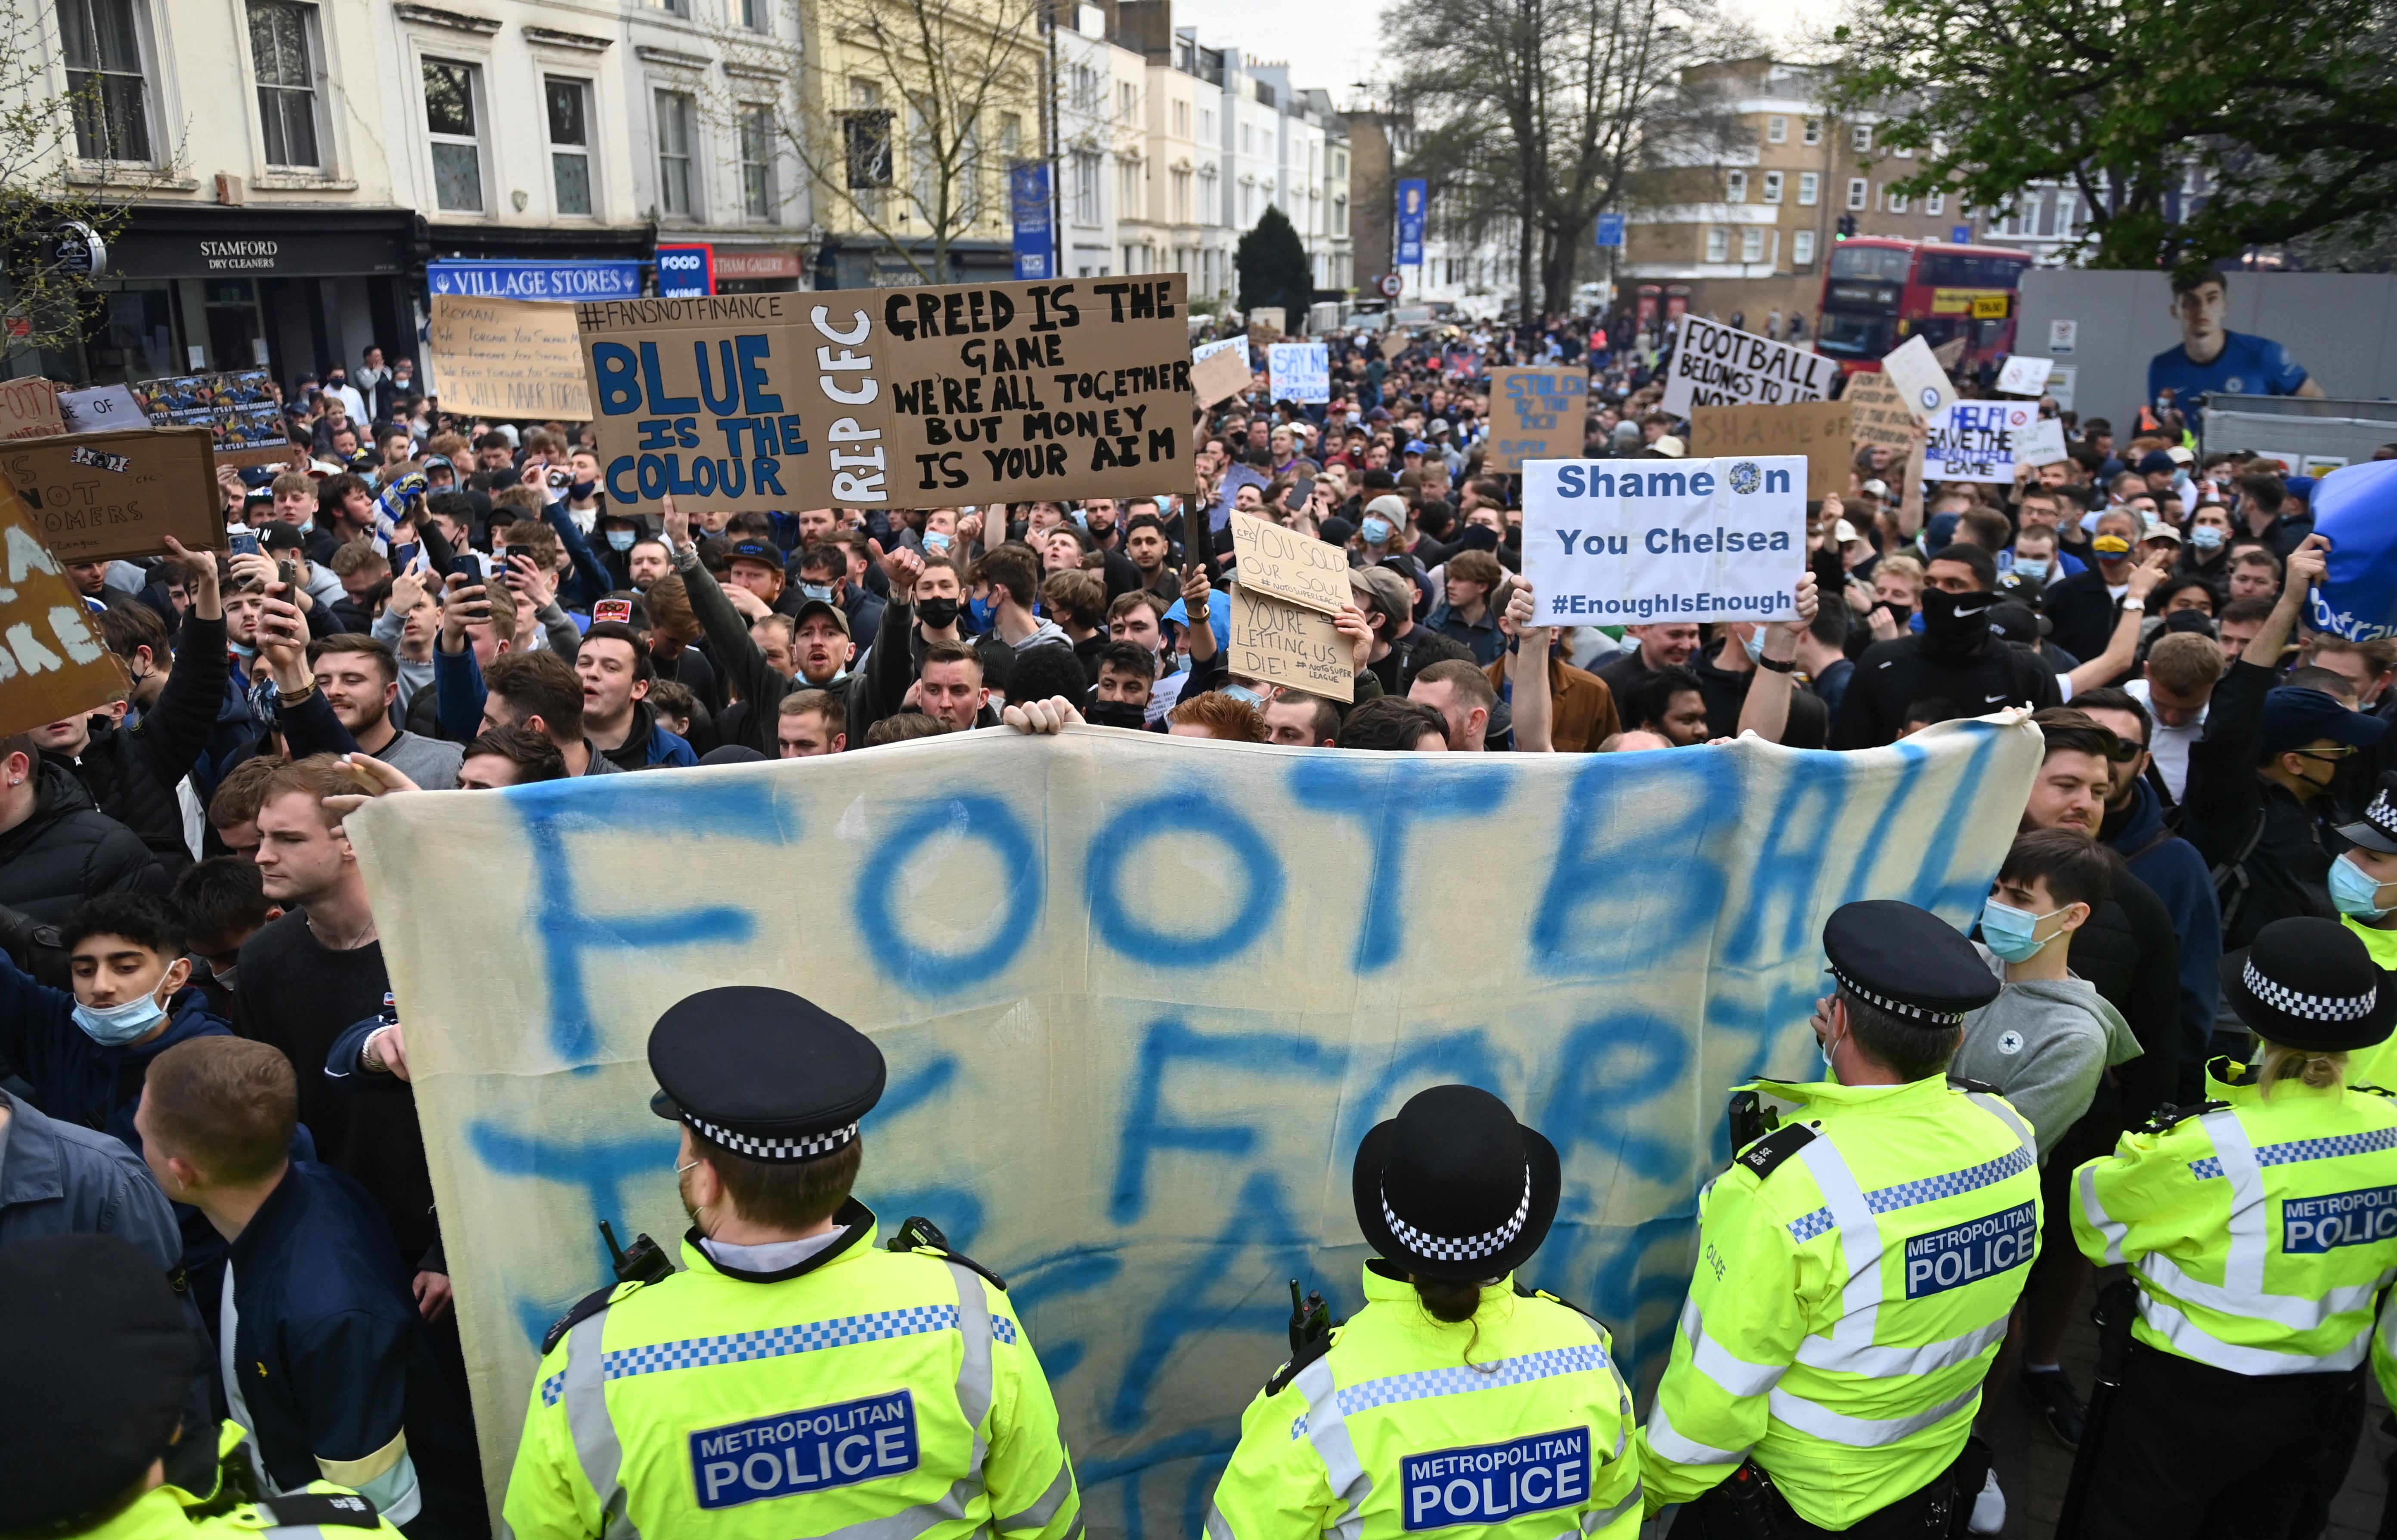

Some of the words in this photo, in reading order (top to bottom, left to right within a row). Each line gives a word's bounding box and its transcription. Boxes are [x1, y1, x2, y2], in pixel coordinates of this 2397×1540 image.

[200, 241, 278, 256] STAMFORD
[209, 259, 227, 269] DRY
[229, 258, 274, 269] CLEANERS
[661, 256, 700, 270] FOOD
[747, 258, 783, 272] GALLERY
[453, 270, 547, 295] VILLAGE
[551, 269, 621, 294] STORES
[666, 288, 702, 297] WINE
[579, 297, 783, 331] #FANSNOTFINANCE
[885, 289, 1014, 341] GREED
[1028, 284, 1080, 331] IS
[1093, 281, 1176, 324] THE
[810, 304, 879, 405] CFC
[961, 334, 1065, 375] GAME
[1274, 348, 1306, 373] SAY
[1311, 347, 1329, 373] NO
[1685, 320, 1818, 389] FOOTBALL
[592, 334, 784, 416] BLUE
[892, 372, 983, 416] WE'RE
[991, 374, 1045, 413] ALL
[1054, 360, 1191, 404] TOGETHER
[1505, 373, 1587, 398] STOLEN
[1680, 353, 1754, 396] BELONGS
[1760, 378, 1782, 402] TO
[0, 381, 54, 420] OOTY
[93, 399, 113, 414] OF
[248, 400, 276, 409] DISGRACE
[439, 381, 458, 403] WE
[465, 381, 499, 409] WILL
[508, 381, 545, 410] NEVER
[1542, 397, 1568, 411] THE
[184, 407, 211, 415] DISGRACE
[925, 416, 1003, 445] BUT
[1023, 404, 1148, 442] MONEY
[1521, 414, 1557, 430] RICH
[1951, 406, 2007, 430] HELP!
[260, 437, 287, 446] DISGRACE
[638, 417, 700, 450] IS
[716, 414, 808, 458] THE
[1701, 413, 1813, 446] SHAME
[1926, 427, 1974, 448] SAVE
[1979, 430, 2013, 451] THE
[915, 451, 969, 490] IS
[982, 443, 1068, 482] YOUR
[1091, 427, 1176, 472] AIM
[1499, 439, 1546, 455] SUPER
[606, 453, 787, 504] COLOUR
[1556, 464, 1715, 498] Shame
[1945, 461, 1994, 476] GAME
[19, 480, 100, 510] NOT
[43, 501, 142, 532] OMERS
[1237, 529, 1255, 540] CFC
[1242, 517, 1295, 560] YOU
[1300, 541, 1345, 572] SOLD
[1555, 529, 1628, 555] You
[1645, 527, 1789, 554] Chelsea
[1243, 556, 1282, 580] OUR
[1296, 571, 1344, 599] SOUL
[1240, 593, 1306, 635] YOU'RE
[1552, 591, 1791, 618] #EnoughIsEnough
[1237, 624, 1307, 660] LETTING
[1313, 644, 1337, 664] US
[1246, 652, 1287, 676] DIE!
[1310, 671, 1339, 683] LEAGUE
[502, 720, 1998, 1063] FOOTBALL
[1748, 1153, 1765, 1166] 1426
[1759, 1147, 1772, 1157] SE
[1908, 1205, 2035, 1257] METROPOLITAN
[1909, 1225, 2035, 1294] POLICE
[700, 1400, 904, 1458] METROPOLITAN
[704, 1426, 909, 1501] POLICE
[1411, 1436, 1581, 1481] METROPOLITAN
[1412, 1460, 1582, 1523] POLICE
